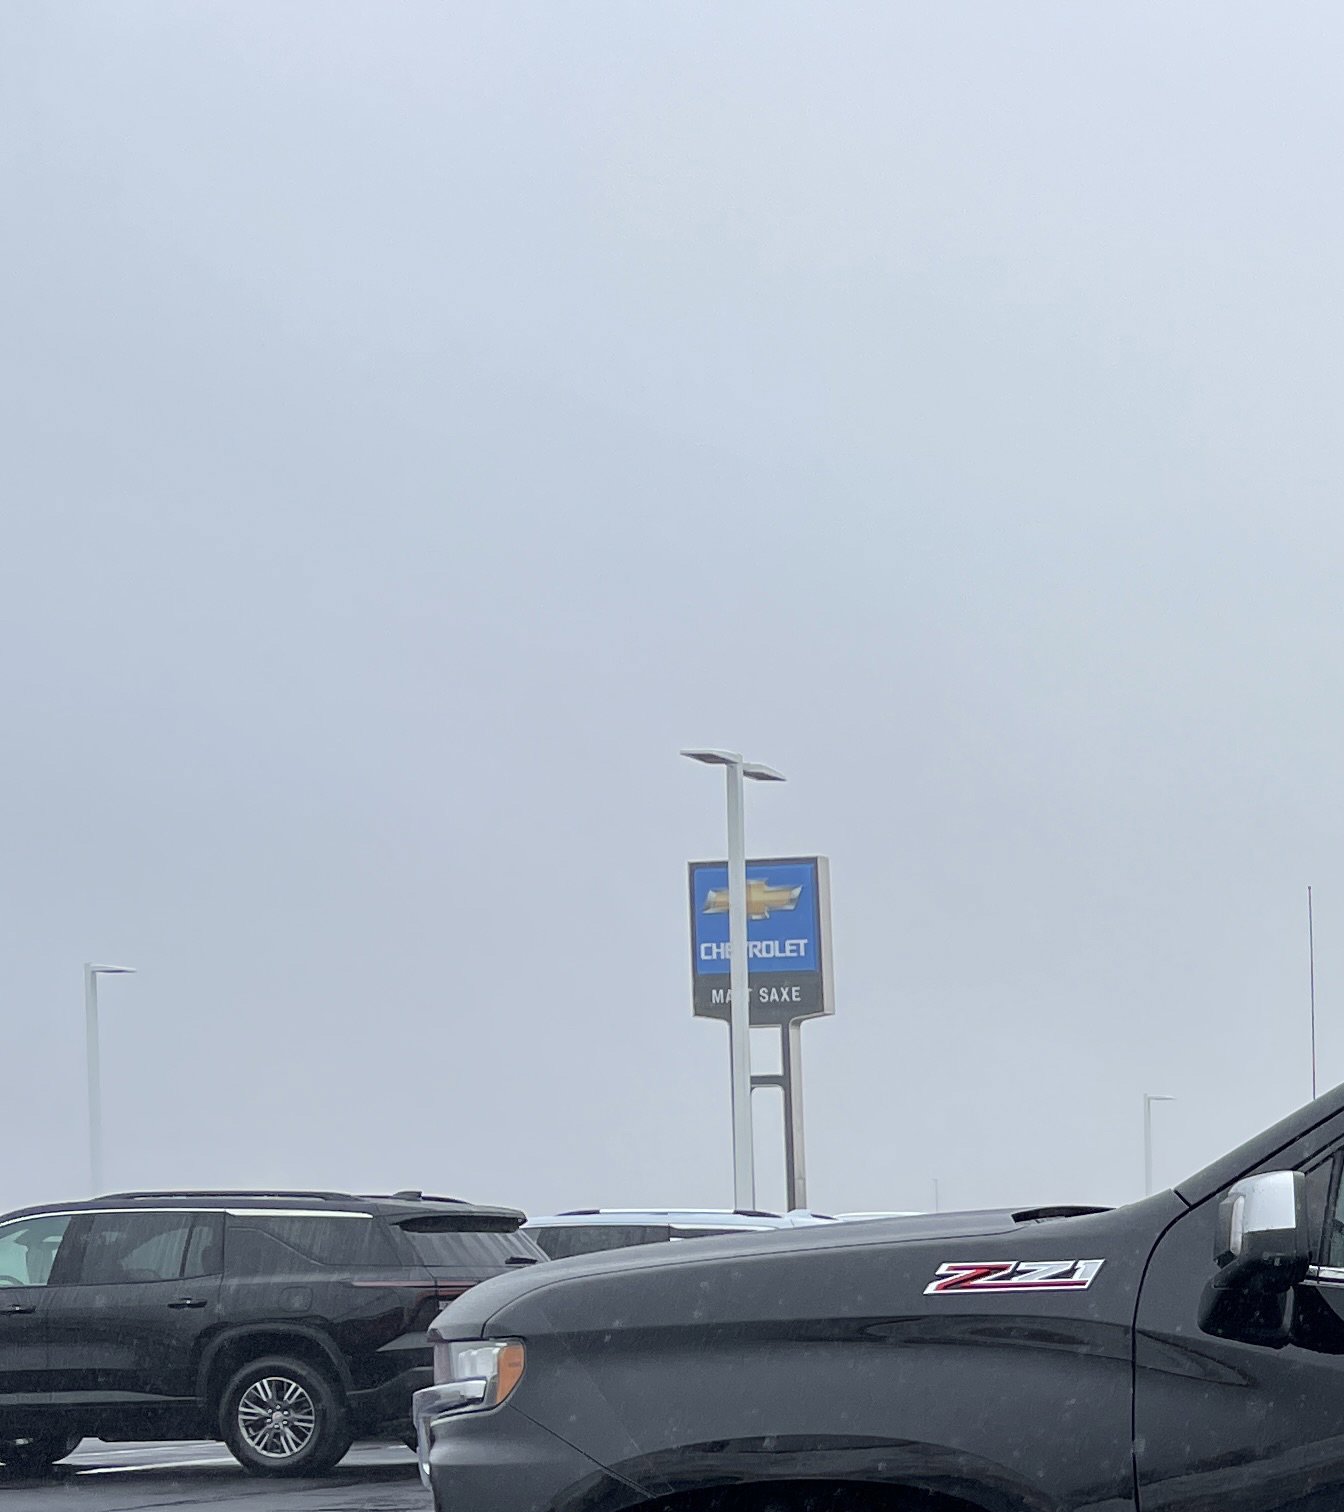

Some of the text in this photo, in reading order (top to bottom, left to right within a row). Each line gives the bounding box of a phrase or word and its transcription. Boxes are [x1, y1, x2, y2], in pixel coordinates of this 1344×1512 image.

[700, 939, 808, 960] CHROLET
[759, 986, 802, 1003] SAXE
[923, 1258, 1106, 1295] Z71
